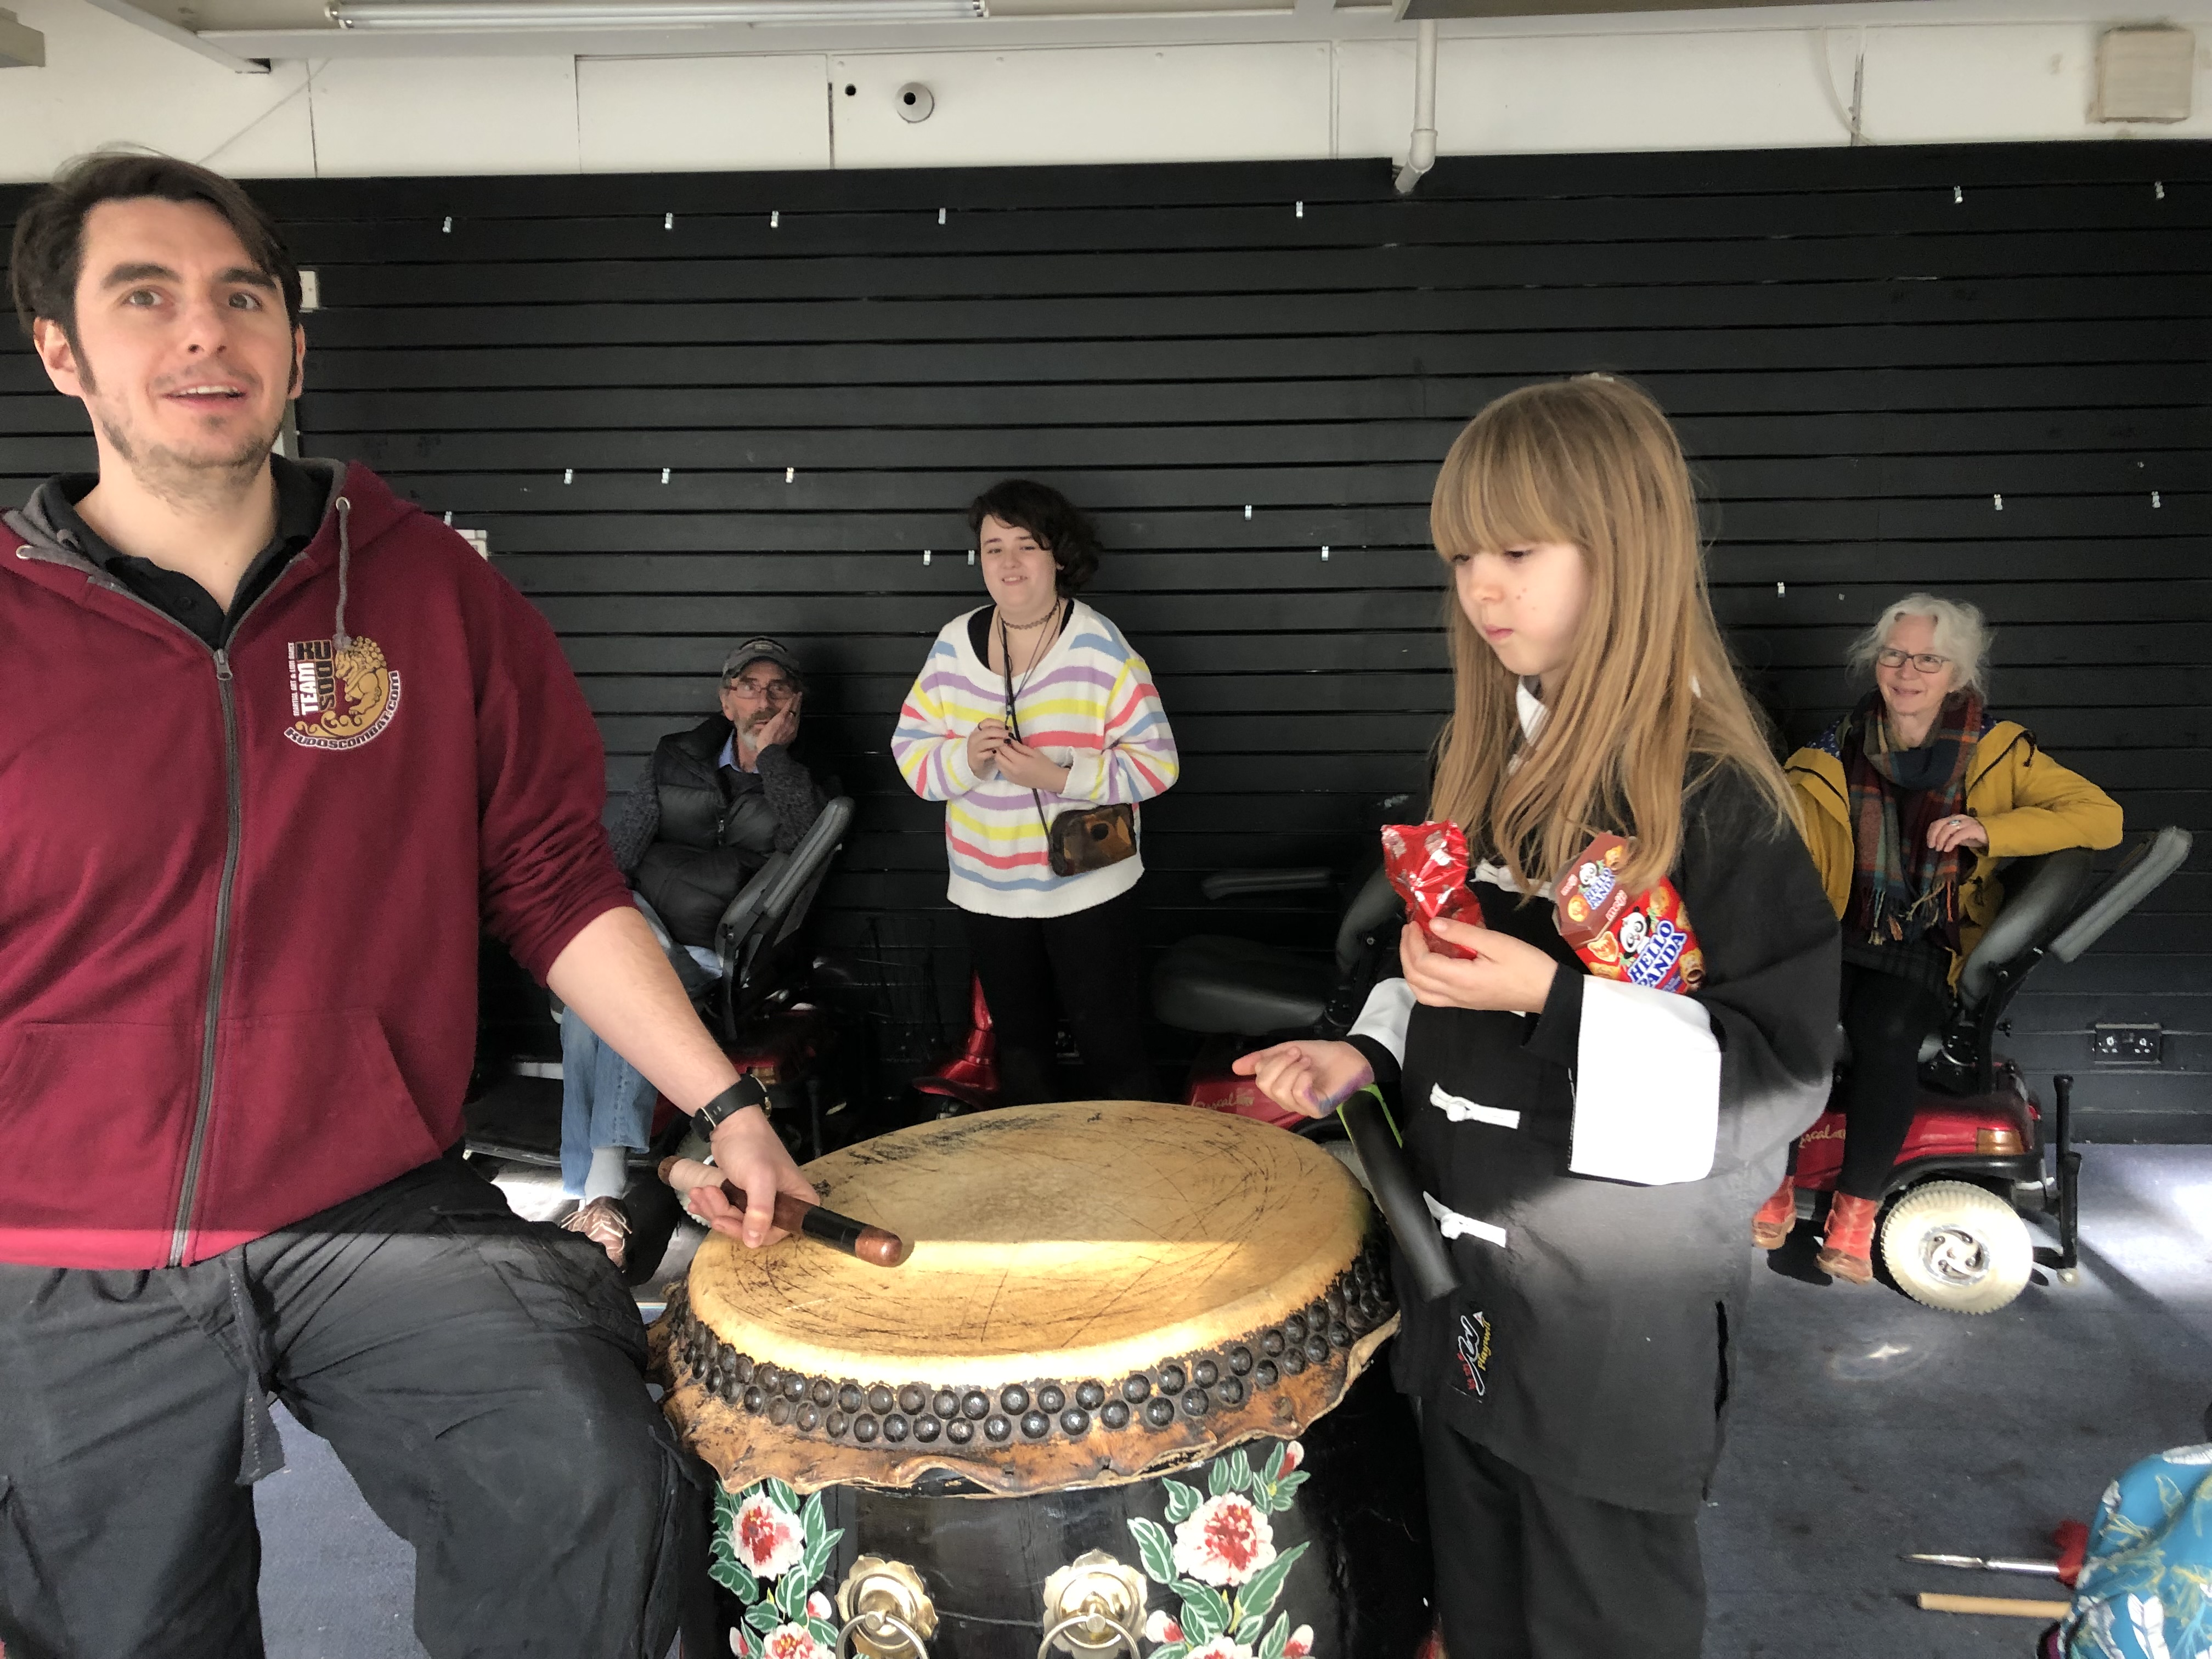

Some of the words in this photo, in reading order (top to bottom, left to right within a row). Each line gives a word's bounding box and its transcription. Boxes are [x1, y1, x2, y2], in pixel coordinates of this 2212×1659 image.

[290, 680, 298, 691] ART
[297, 663, 318, 715] TEAM
[1628, 920, 1675, 983] HELLO
